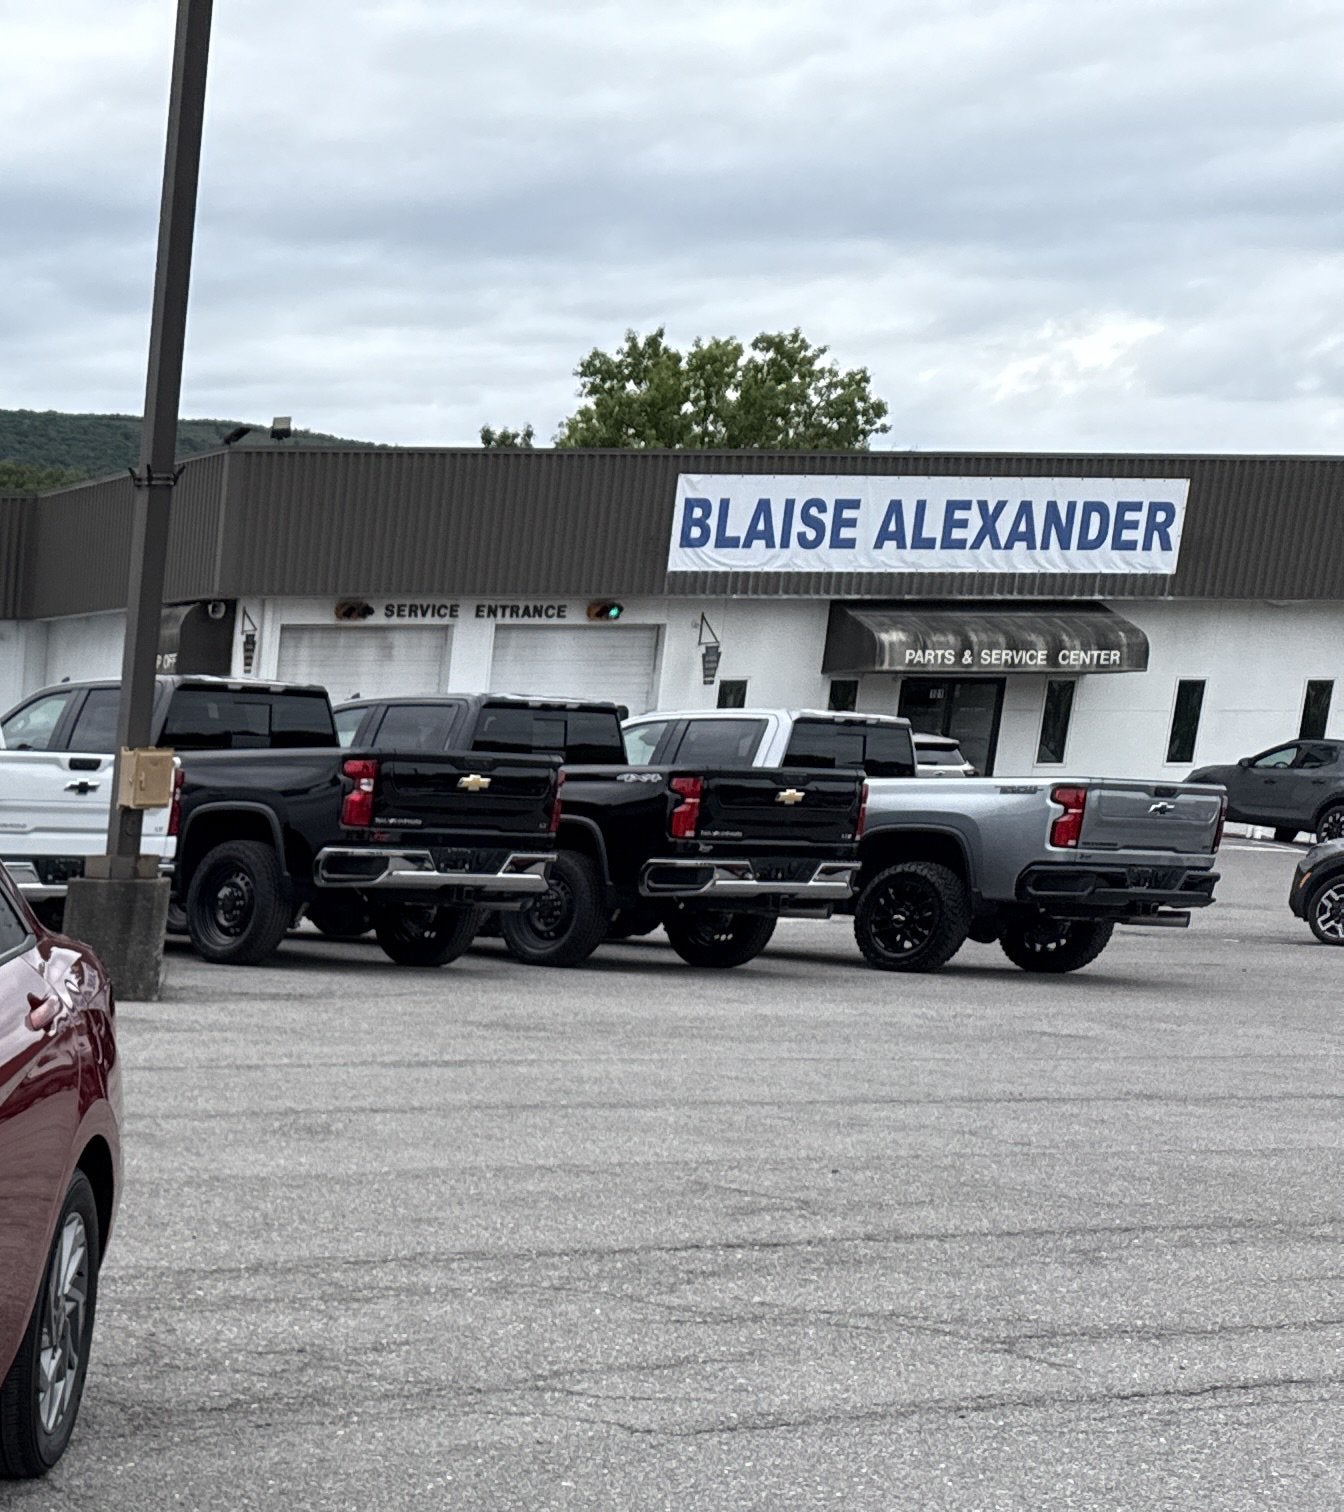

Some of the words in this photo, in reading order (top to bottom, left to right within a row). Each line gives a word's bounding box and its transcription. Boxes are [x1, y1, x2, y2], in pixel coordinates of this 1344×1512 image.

[678, 497, 861, 549] BLAISE
[873, 499, 1177, 552] ALEXANDER
[384, 604, 460, 618] SERVICE
[475, 604, 567, 619] ENTRANCE
[904, 650, 955, 665] PARTS
[961, 650, 973, 664] &
[980, 650, 1048, 665] SERVICE
[1058, 650, 1121, 665] CENTER
